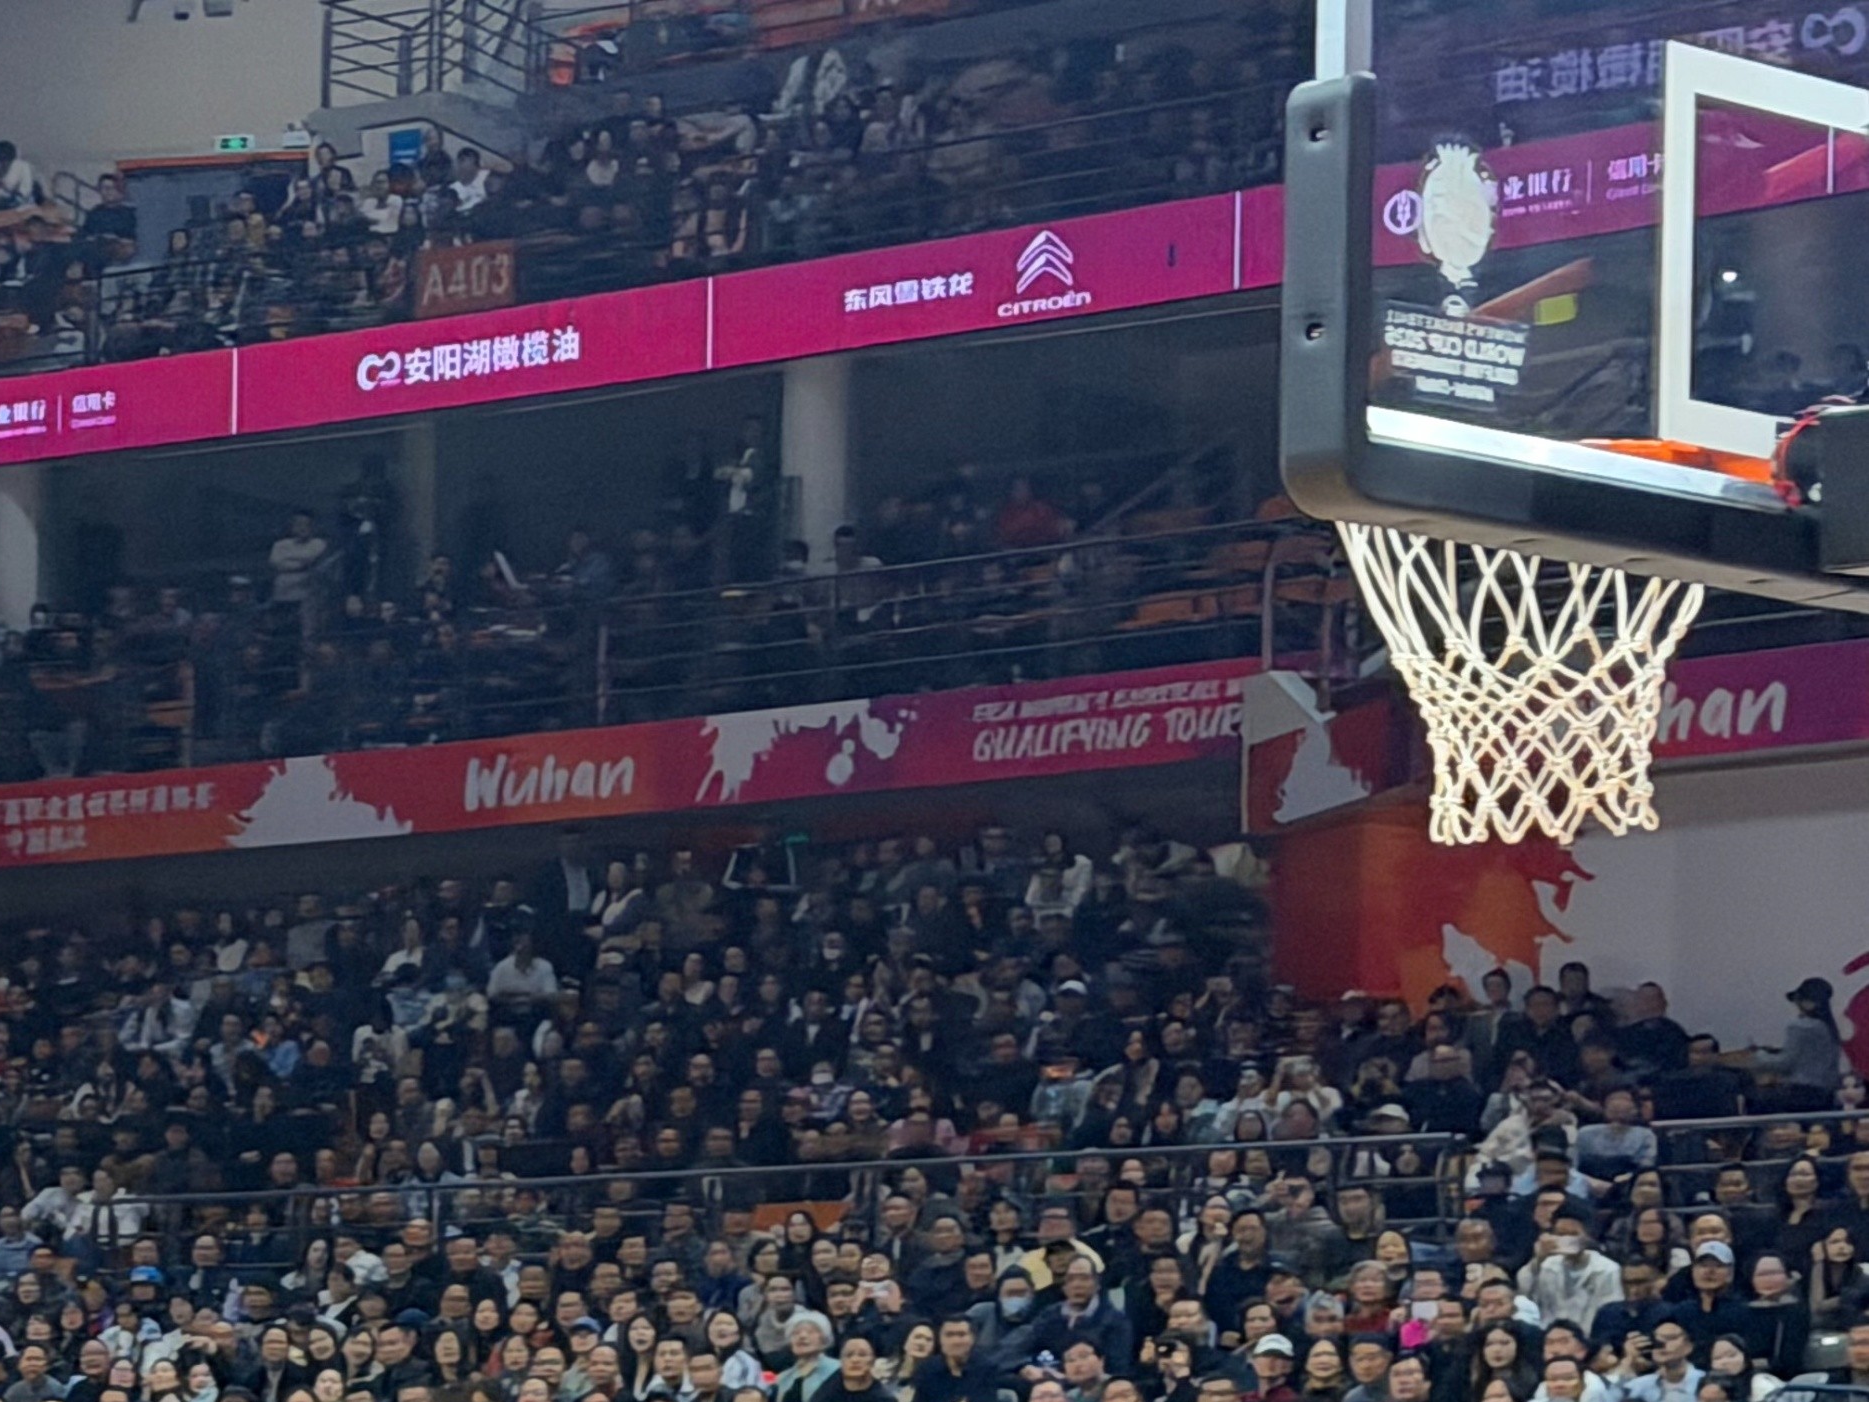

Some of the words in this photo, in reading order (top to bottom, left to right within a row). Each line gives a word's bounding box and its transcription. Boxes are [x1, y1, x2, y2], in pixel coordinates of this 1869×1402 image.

[424, 254, 511, 304] A403
[404, 325, 581, 384] 安阳湖橄榄油
[974, 713, 1151, 761] QUALIFYING
[1163, 702, 1242, 744] TOUR
[1658, 681, 1788, 742] han
[464, 753, 635, 811] Wuhan
